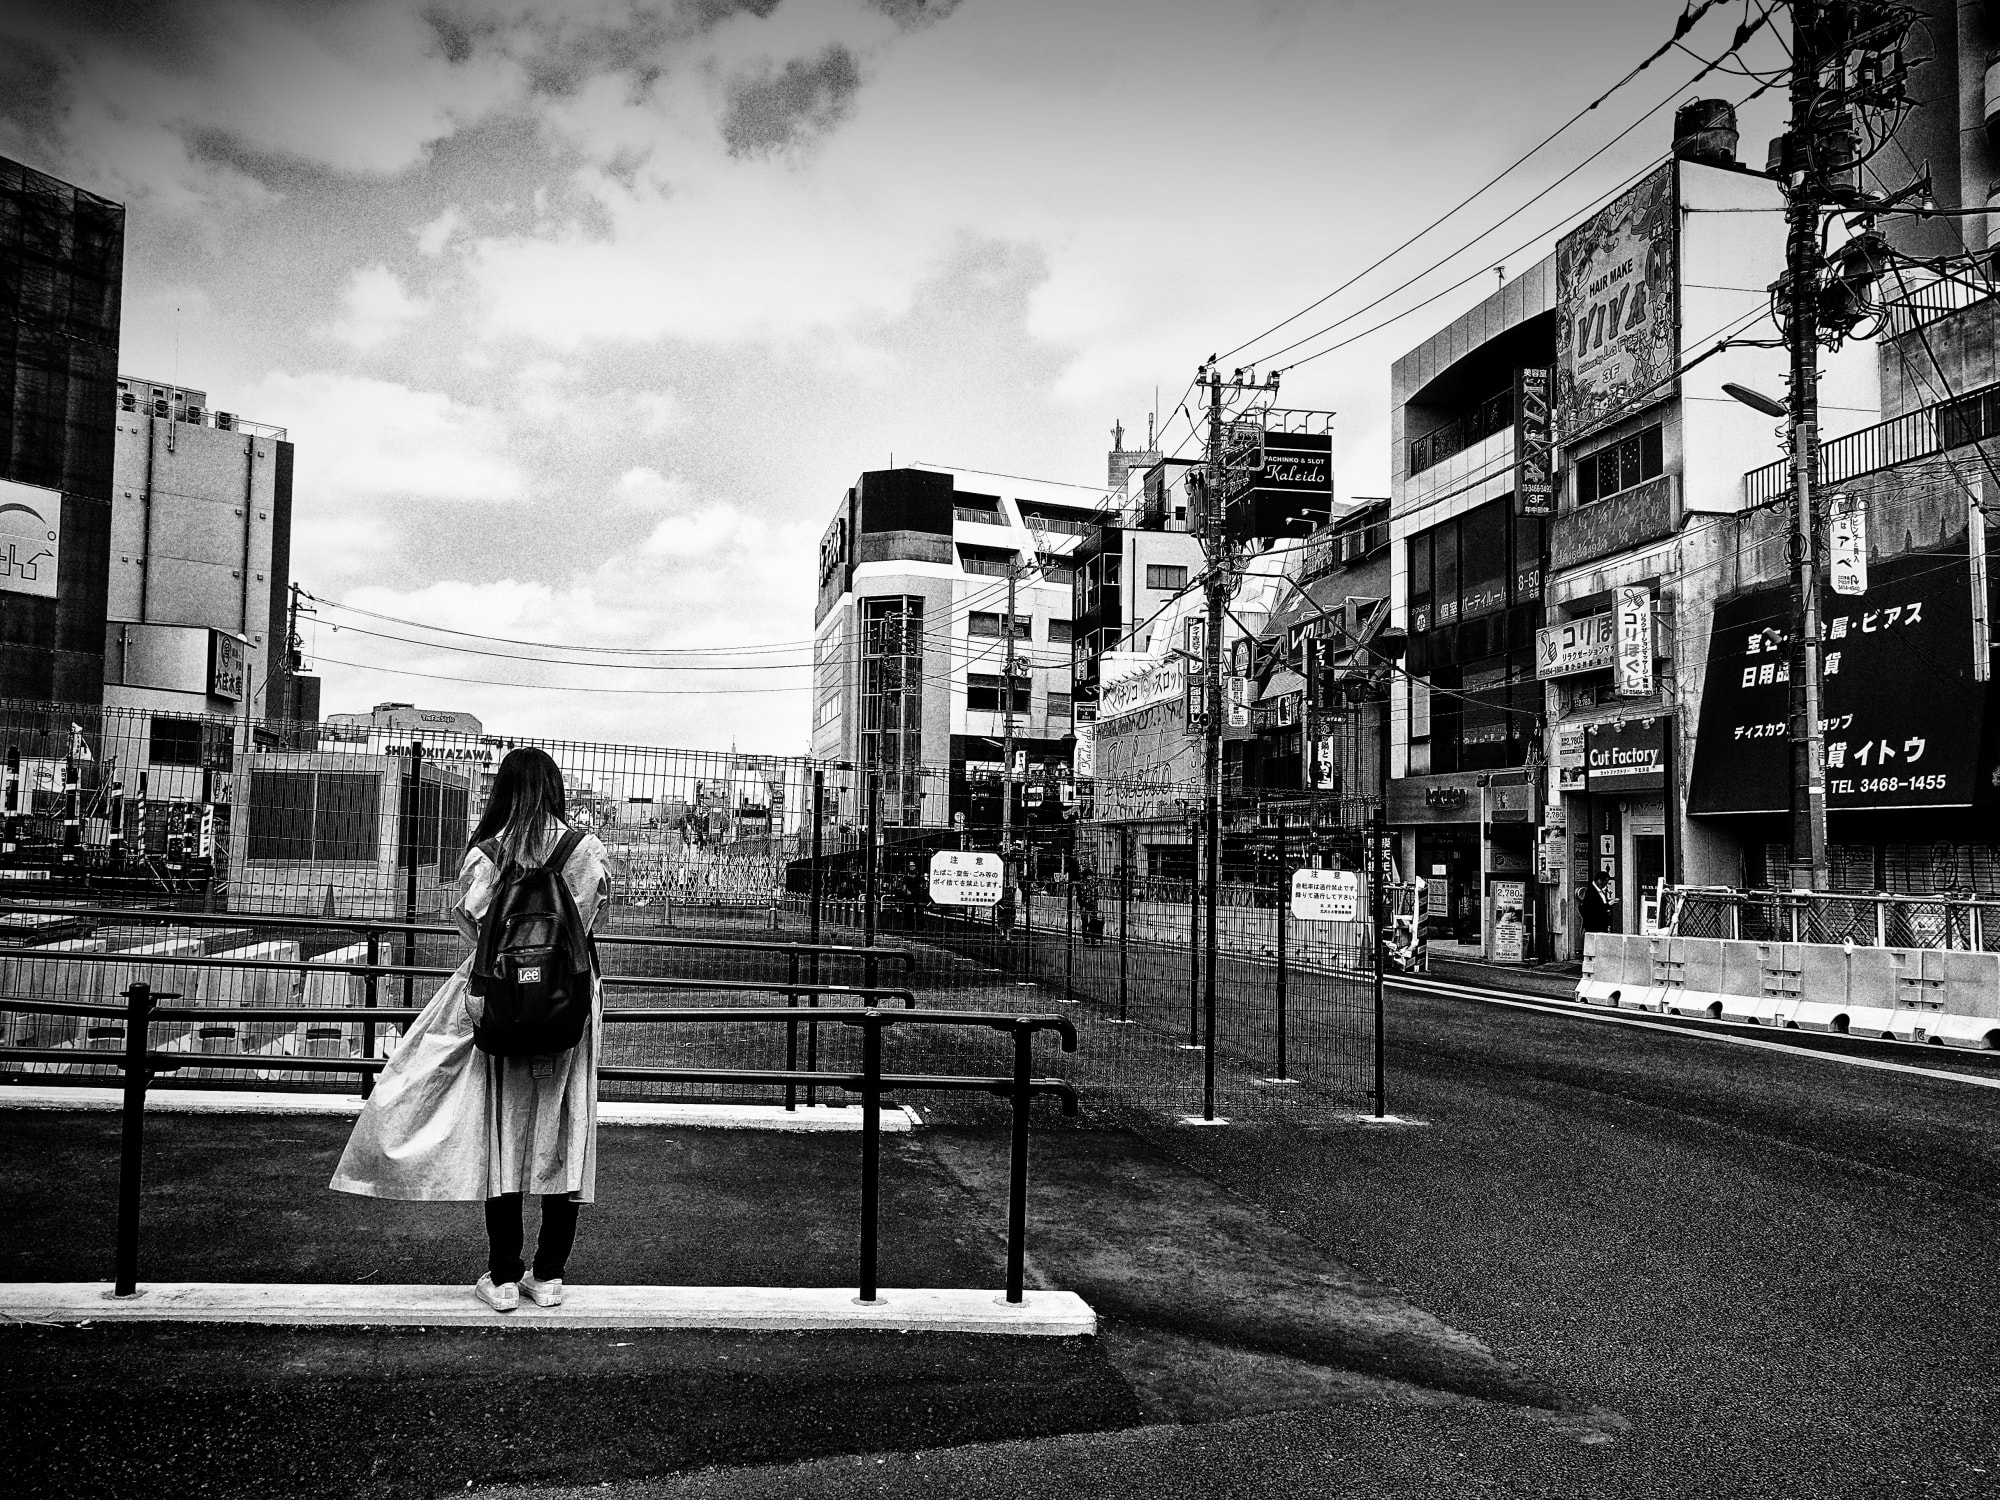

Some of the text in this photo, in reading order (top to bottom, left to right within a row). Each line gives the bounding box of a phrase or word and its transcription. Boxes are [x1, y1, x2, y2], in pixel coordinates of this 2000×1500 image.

[1590, 258, 1633, 298] HAIR MAKE
[1578, 280, 1646, 358] VIVA
[1523, 368, 1547, 378] 美容室
[1602, 363, 1620, 383] 3F
[1263, 456, 1298, 464] PACHINKO
[1264, 465, 1325, 482] Kaleido
[1530, 495, 1545, 503] 3F
[1518, 569, 1540, 590] 8-50
[1624, 612, 1640, 689] コリほぐし
[1153, 662, 1183, 697] スロット
[1589, 747, 1659, 768] Cut Factory
[1854, 736, 1926, 766] イトウ
[1831, 774, 1947, 794] TEL 3468-1455
[1381, 837, 1392, 906] 楽天モバル
[520, 969, 539, 982] Lee
